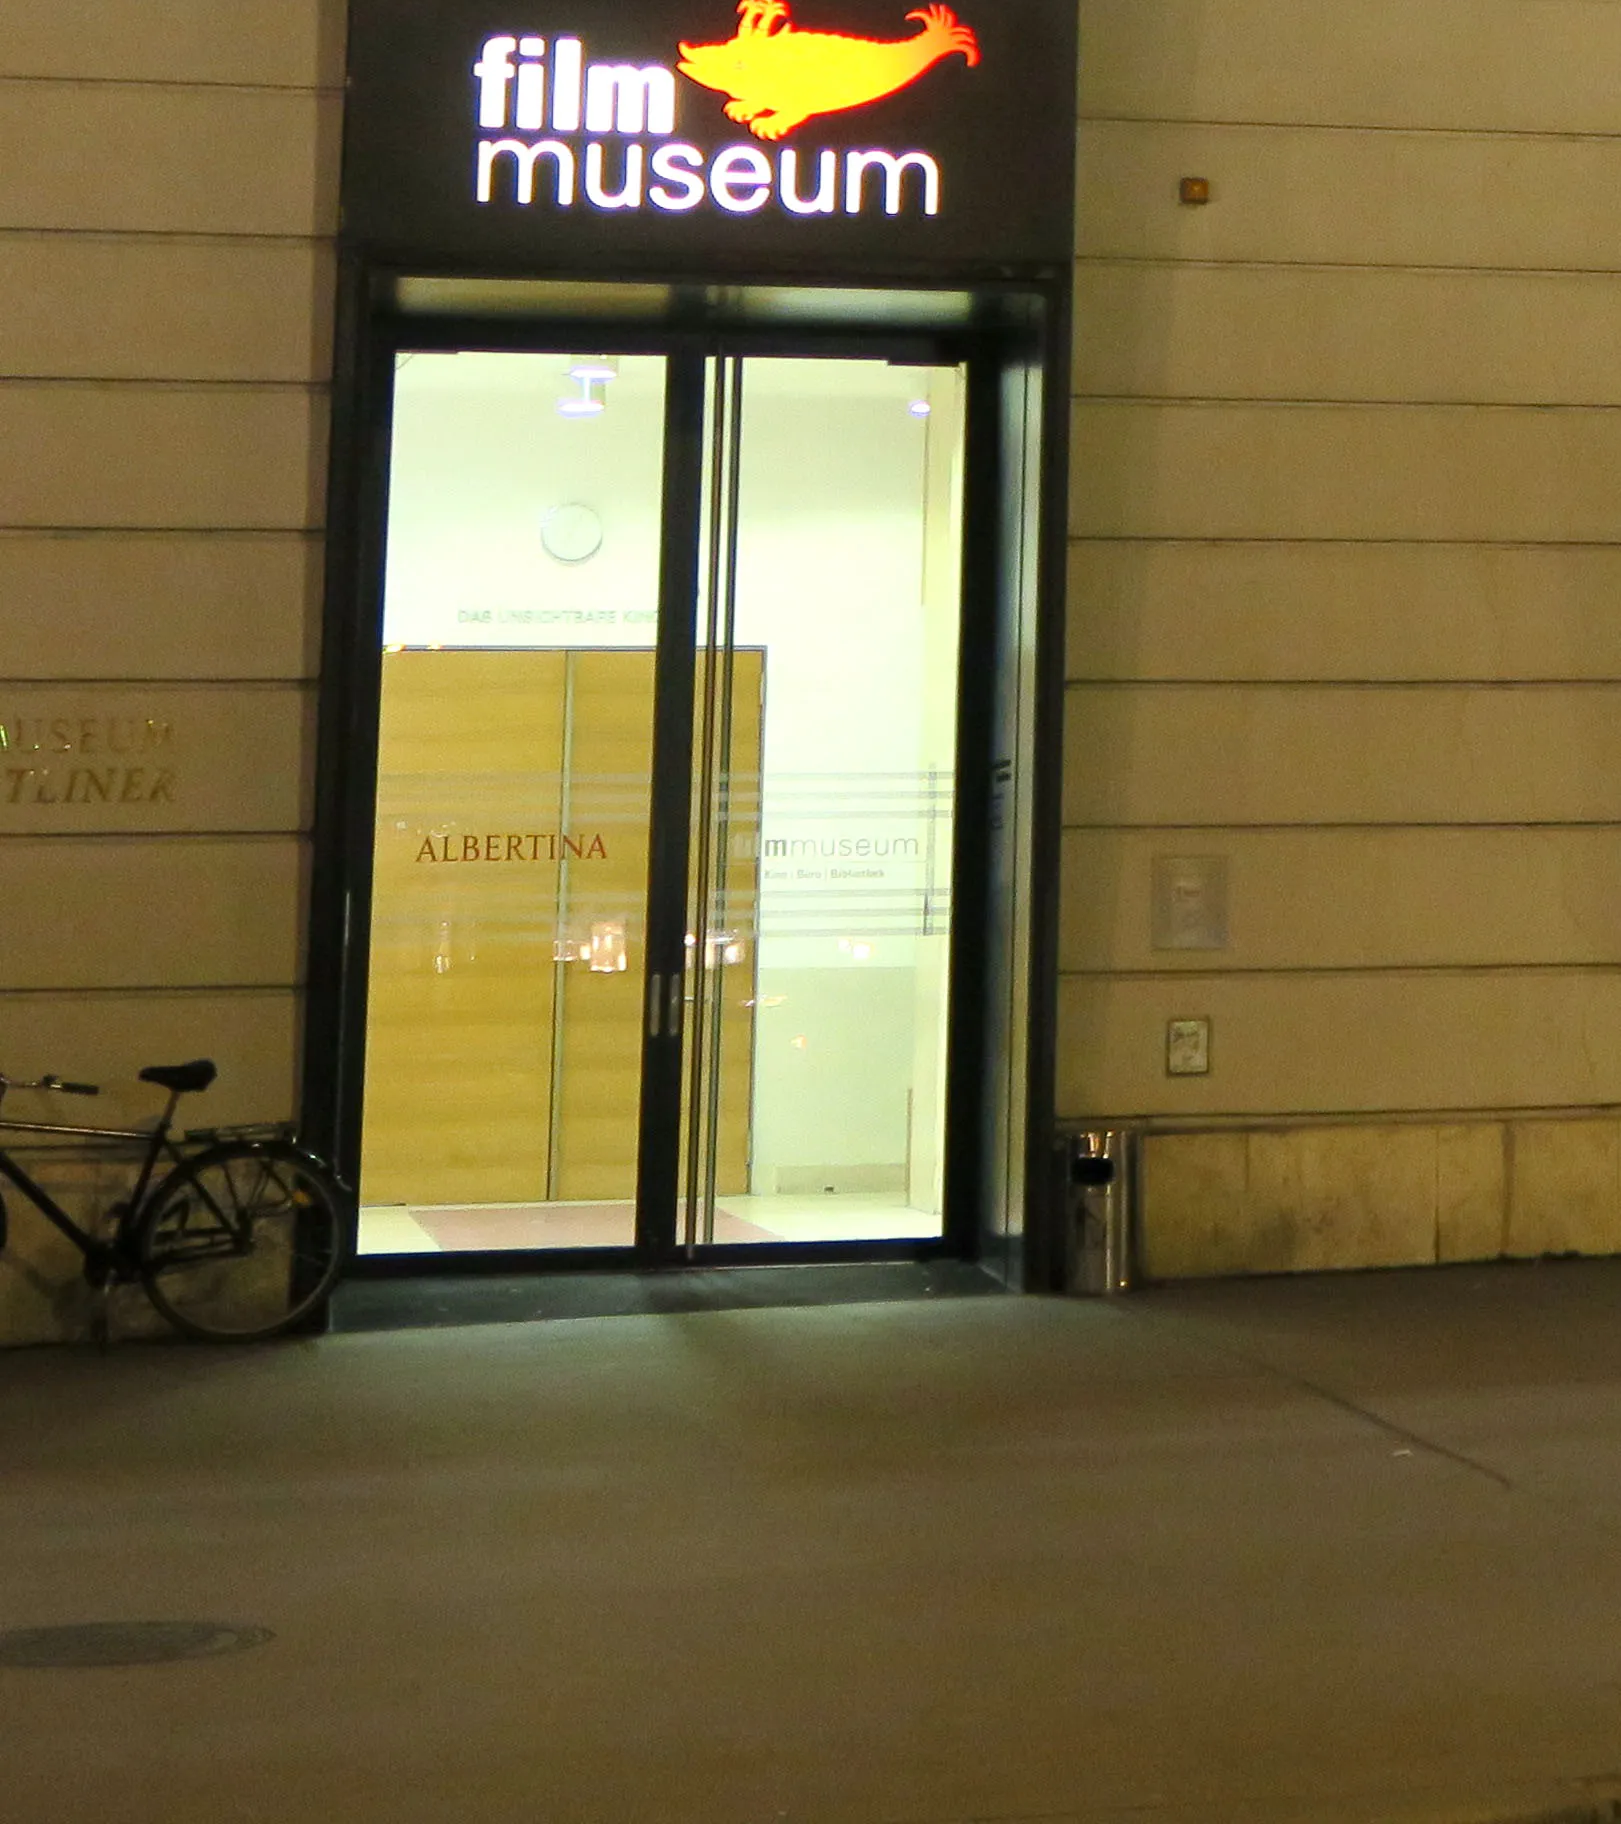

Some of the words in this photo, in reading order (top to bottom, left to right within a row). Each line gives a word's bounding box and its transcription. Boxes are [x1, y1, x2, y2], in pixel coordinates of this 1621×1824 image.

[473, 36, 676, 133] film
[475, 137, 940, 216] museum
[0, 717, 174, 754] USEUM
[415, 834, 608, 862] ALBERTINA
